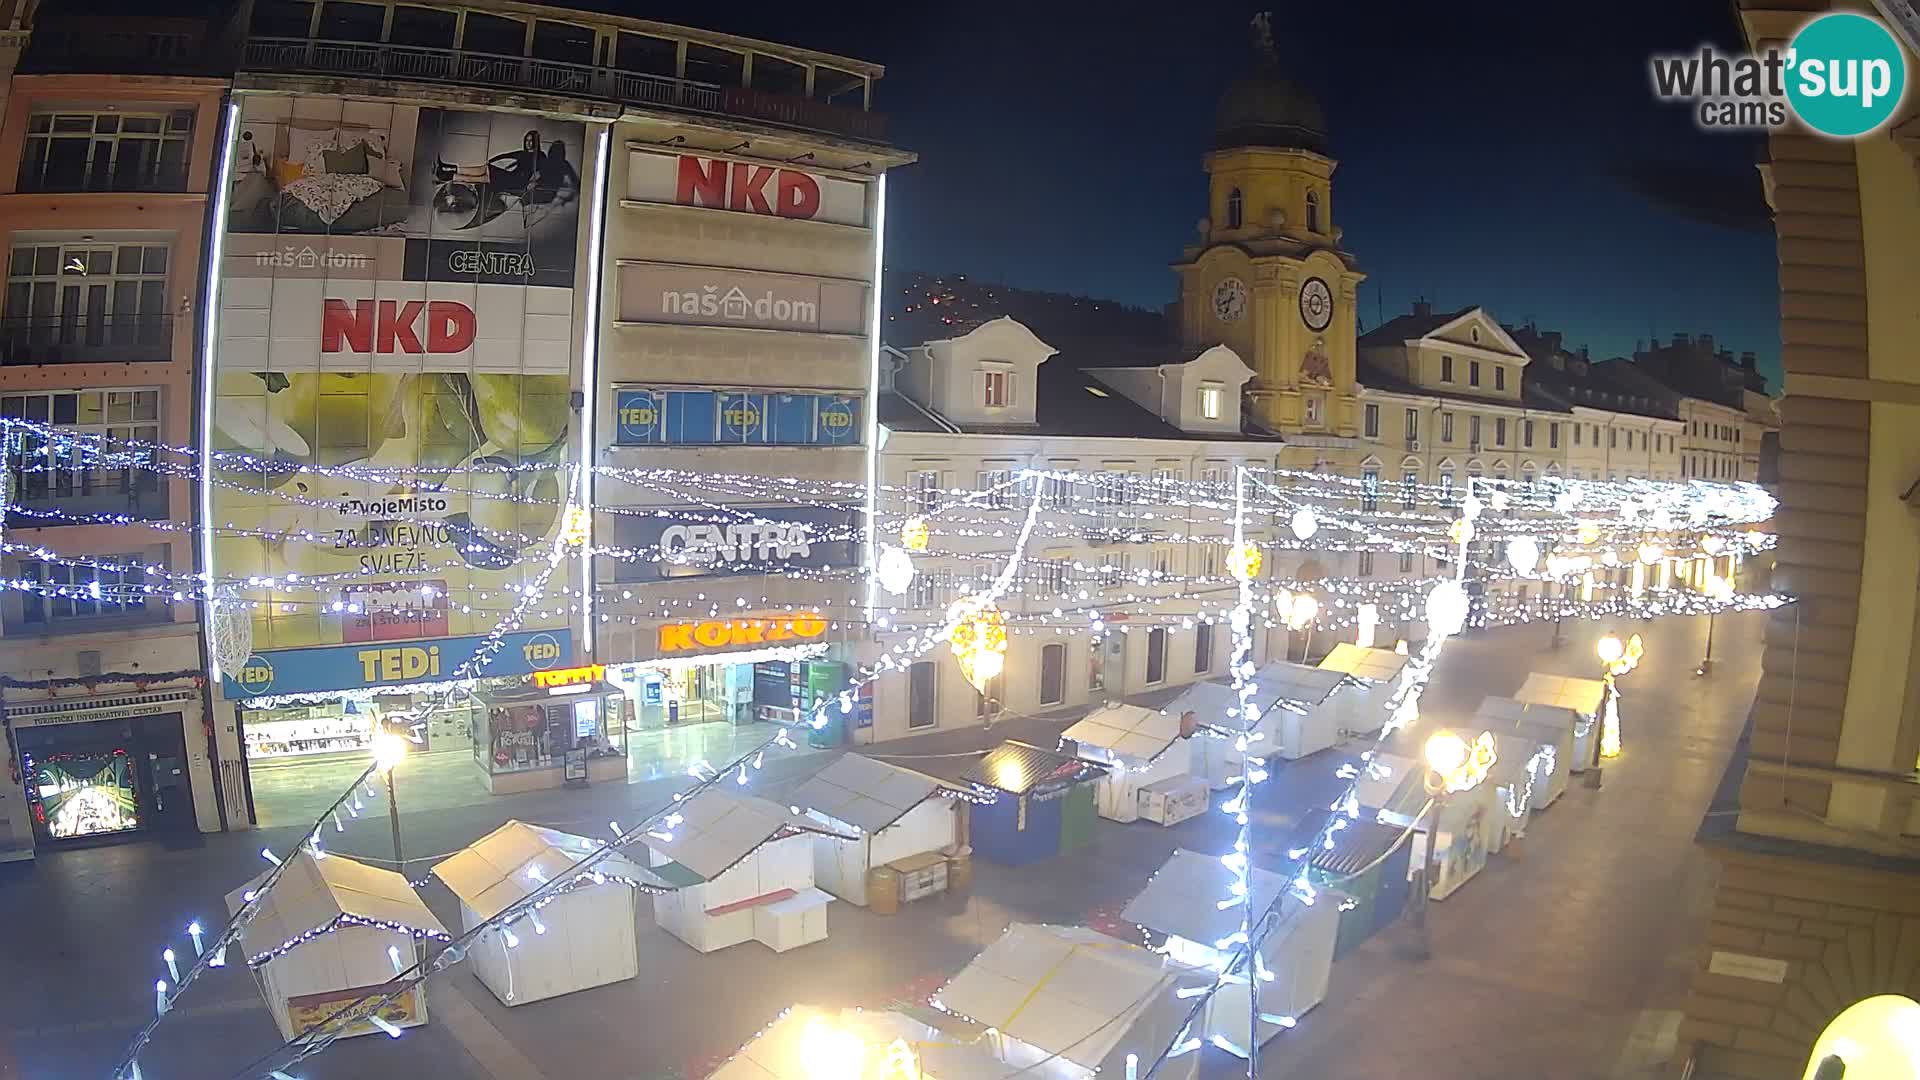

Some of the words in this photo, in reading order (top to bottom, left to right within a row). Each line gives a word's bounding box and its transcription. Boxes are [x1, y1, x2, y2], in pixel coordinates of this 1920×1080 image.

[676, 154, 821, 220] NKD
[255, 245, 295, 268] naš
[320, 248, 368, 269] dom
[449, 250, 536, 276] CENTRA
[662, 284, 719, 317] naš
[754, 290, 816, 323] dom
[322, 298, 477, 354] NKD
[619, 408, 658, 425] TEDi
[723, 409, 760, 426] TEDi
[339, 498, 447, 516] #TvojeMisto
[334, 528, 358, 548] ZA
[368, 525, 449, 548] DNEVNO
[659, 521, 810, 563] CENTRA
[360, 547, 426, 574] SVJEŽE
[657, 612, 828, 652] KORZO
[358, 647, 441, 682] TEDi
[523, 644, 561, 660] TEDi
